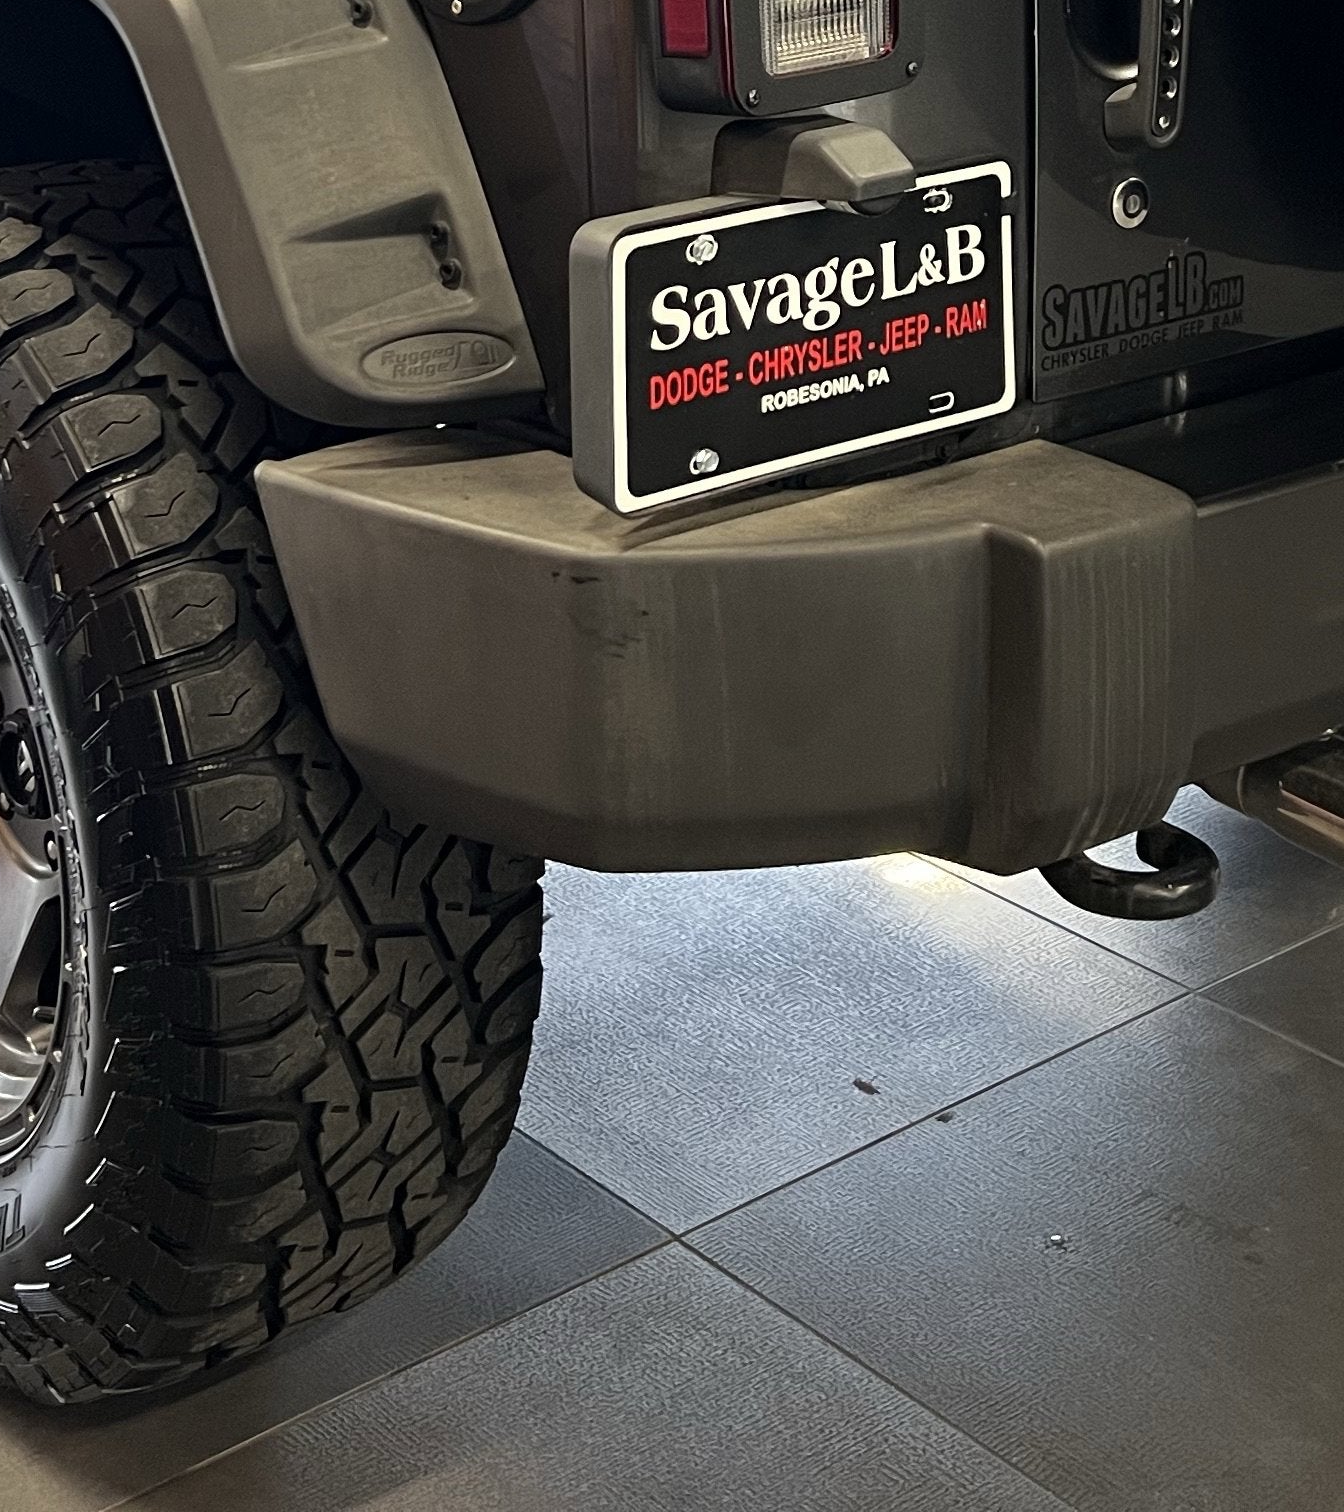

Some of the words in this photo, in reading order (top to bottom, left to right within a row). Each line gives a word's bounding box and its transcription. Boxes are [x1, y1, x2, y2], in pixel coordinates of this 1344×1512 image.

[380, 345, 456, 366] Rugged
[649, 358, 730, 411] DODGE
[748, 329, 864, 386] CHRYSLER
[879, 313, 930, 356] JEEP
[945, 298, 988, 339] RAM
[1040, 342, 1110, 372] CHRYSLER
[1118, 327, 1169, 354] DODGE
[1175, 319, 1204, 339] JEEP
[1211, 311, 1244, 331] RAM
[391, 360, 450, 379] Ridge
[760, 372, 865, 414] ROBESONIA,
[867, 366, 891, 388] PA
